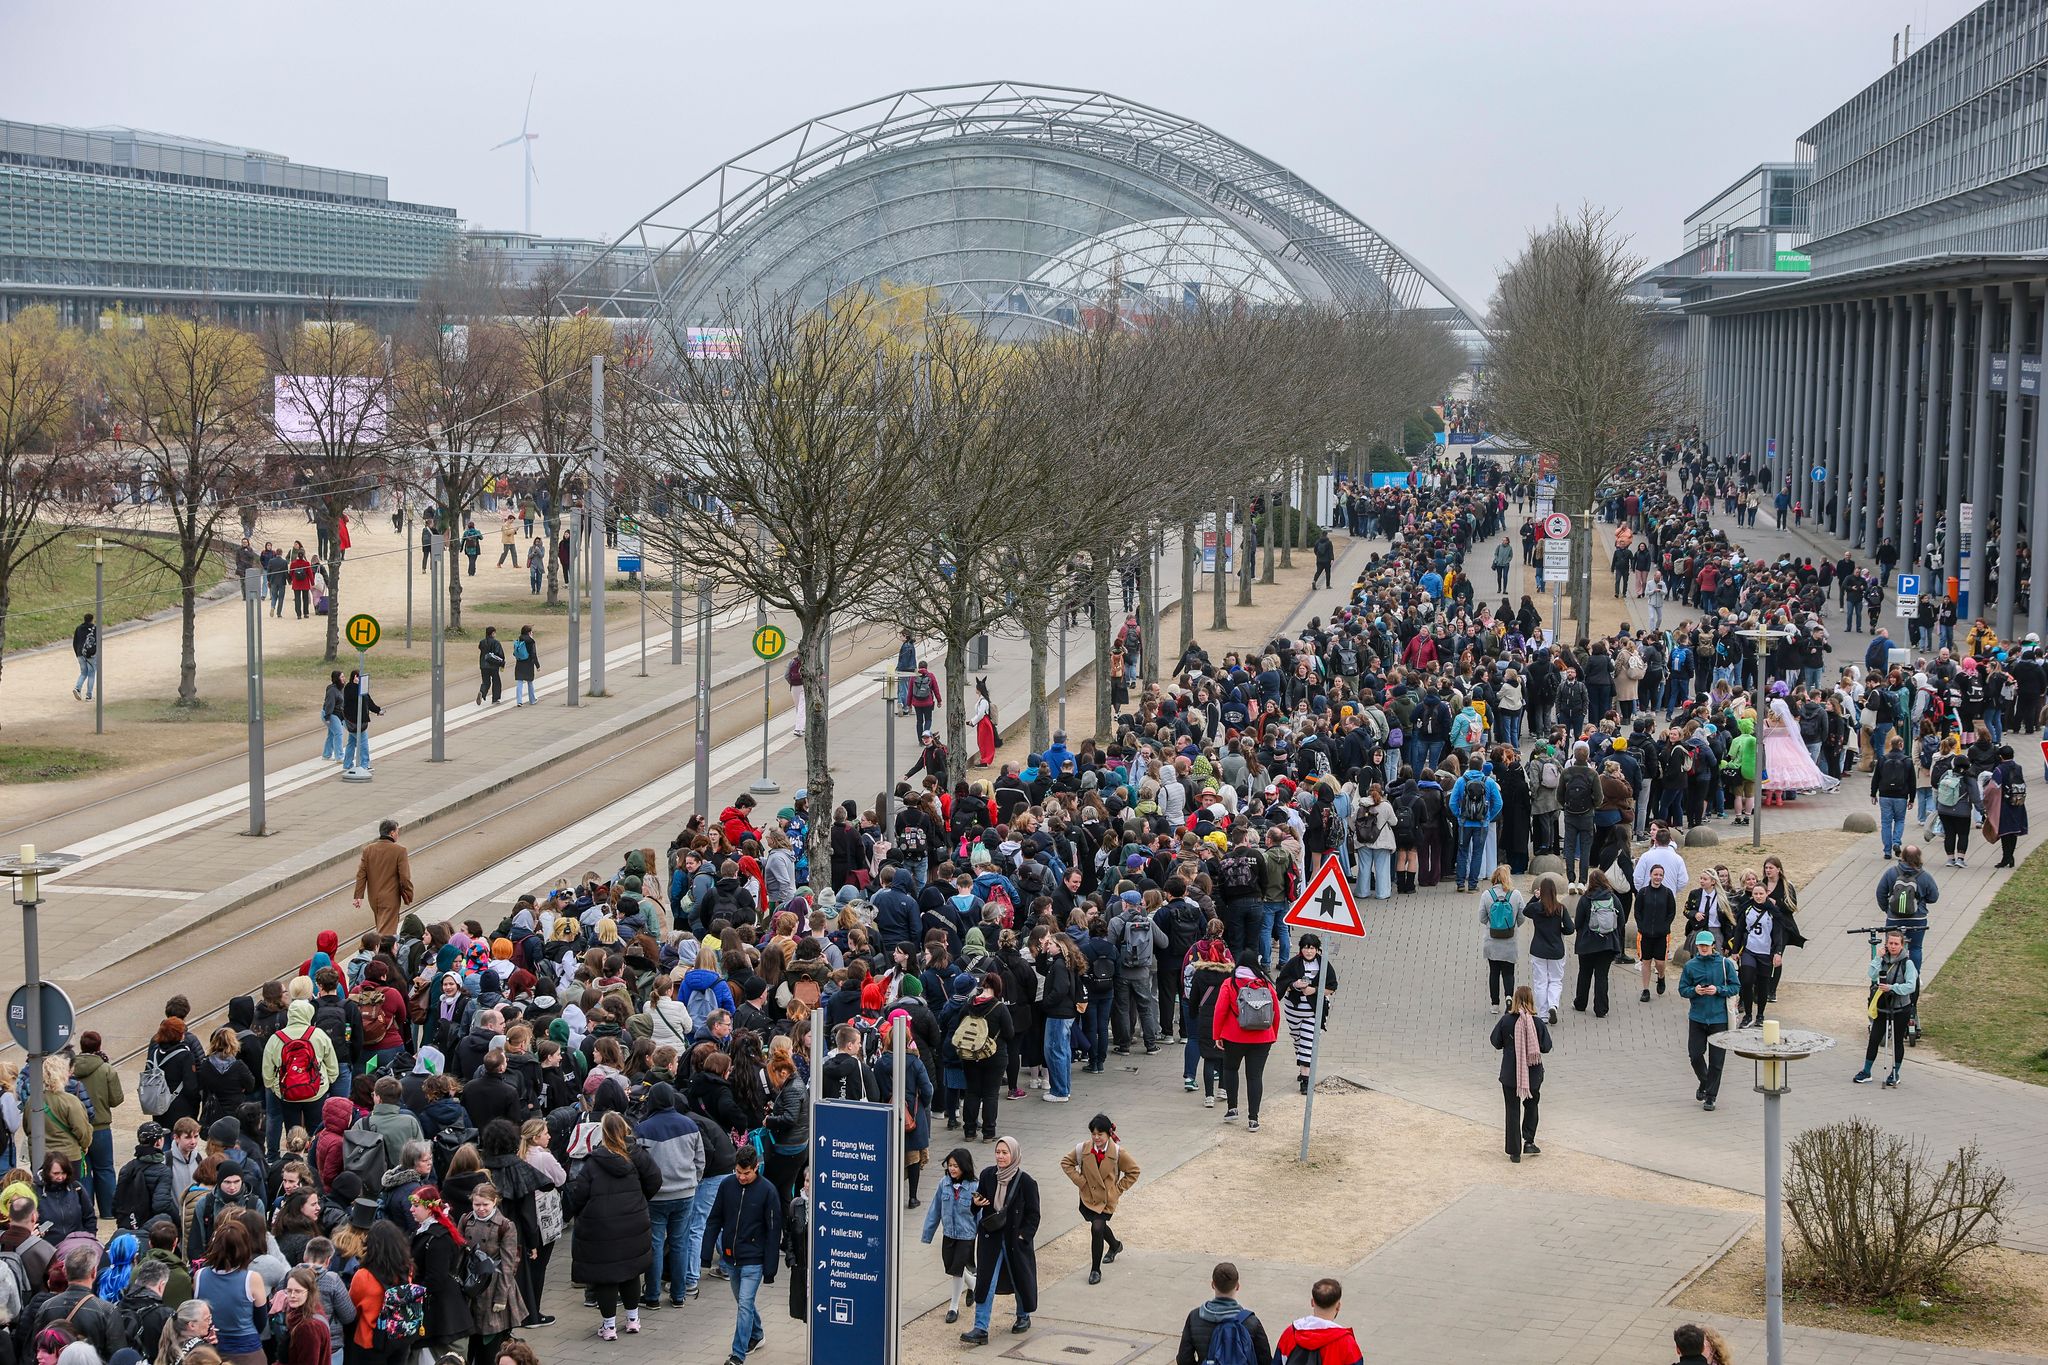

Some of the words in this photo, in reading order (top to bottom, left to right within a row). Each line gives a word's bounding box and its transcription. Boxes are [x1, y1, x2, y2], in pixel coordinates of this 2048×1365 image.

[1902, 577, 1915, 593] P
[355, 621, 371, 642] H
[761, 632, 776, 652] H
[832, 1139, 858, 1150] Eingang
[858, 1142, 875, 1151] West
[832, 1149, 859, 1160] Entrance
[860, 1152, 877, 1162] West
[831, 1169, 857, 1181] Eingang
[858, 1172, 869, 1181] Ost
[831, 1180, 859, 1191] Entrance
[860, 1183, 874, 1192] East
[831, 1200, 844, 1210] CCL
[831, 1209, 850, 1217] Congress
[864, 1213, 879, 1221] Leipzig
[831, 1227, 863, 1239] Halle:EINS
[830, 1248, 867, 1260] Messehaus/
[830, 1258, 851, 1268] Presse
[830, 1269, 878, 1282] Administration/
[830, 1279, 847, 1289] Press
